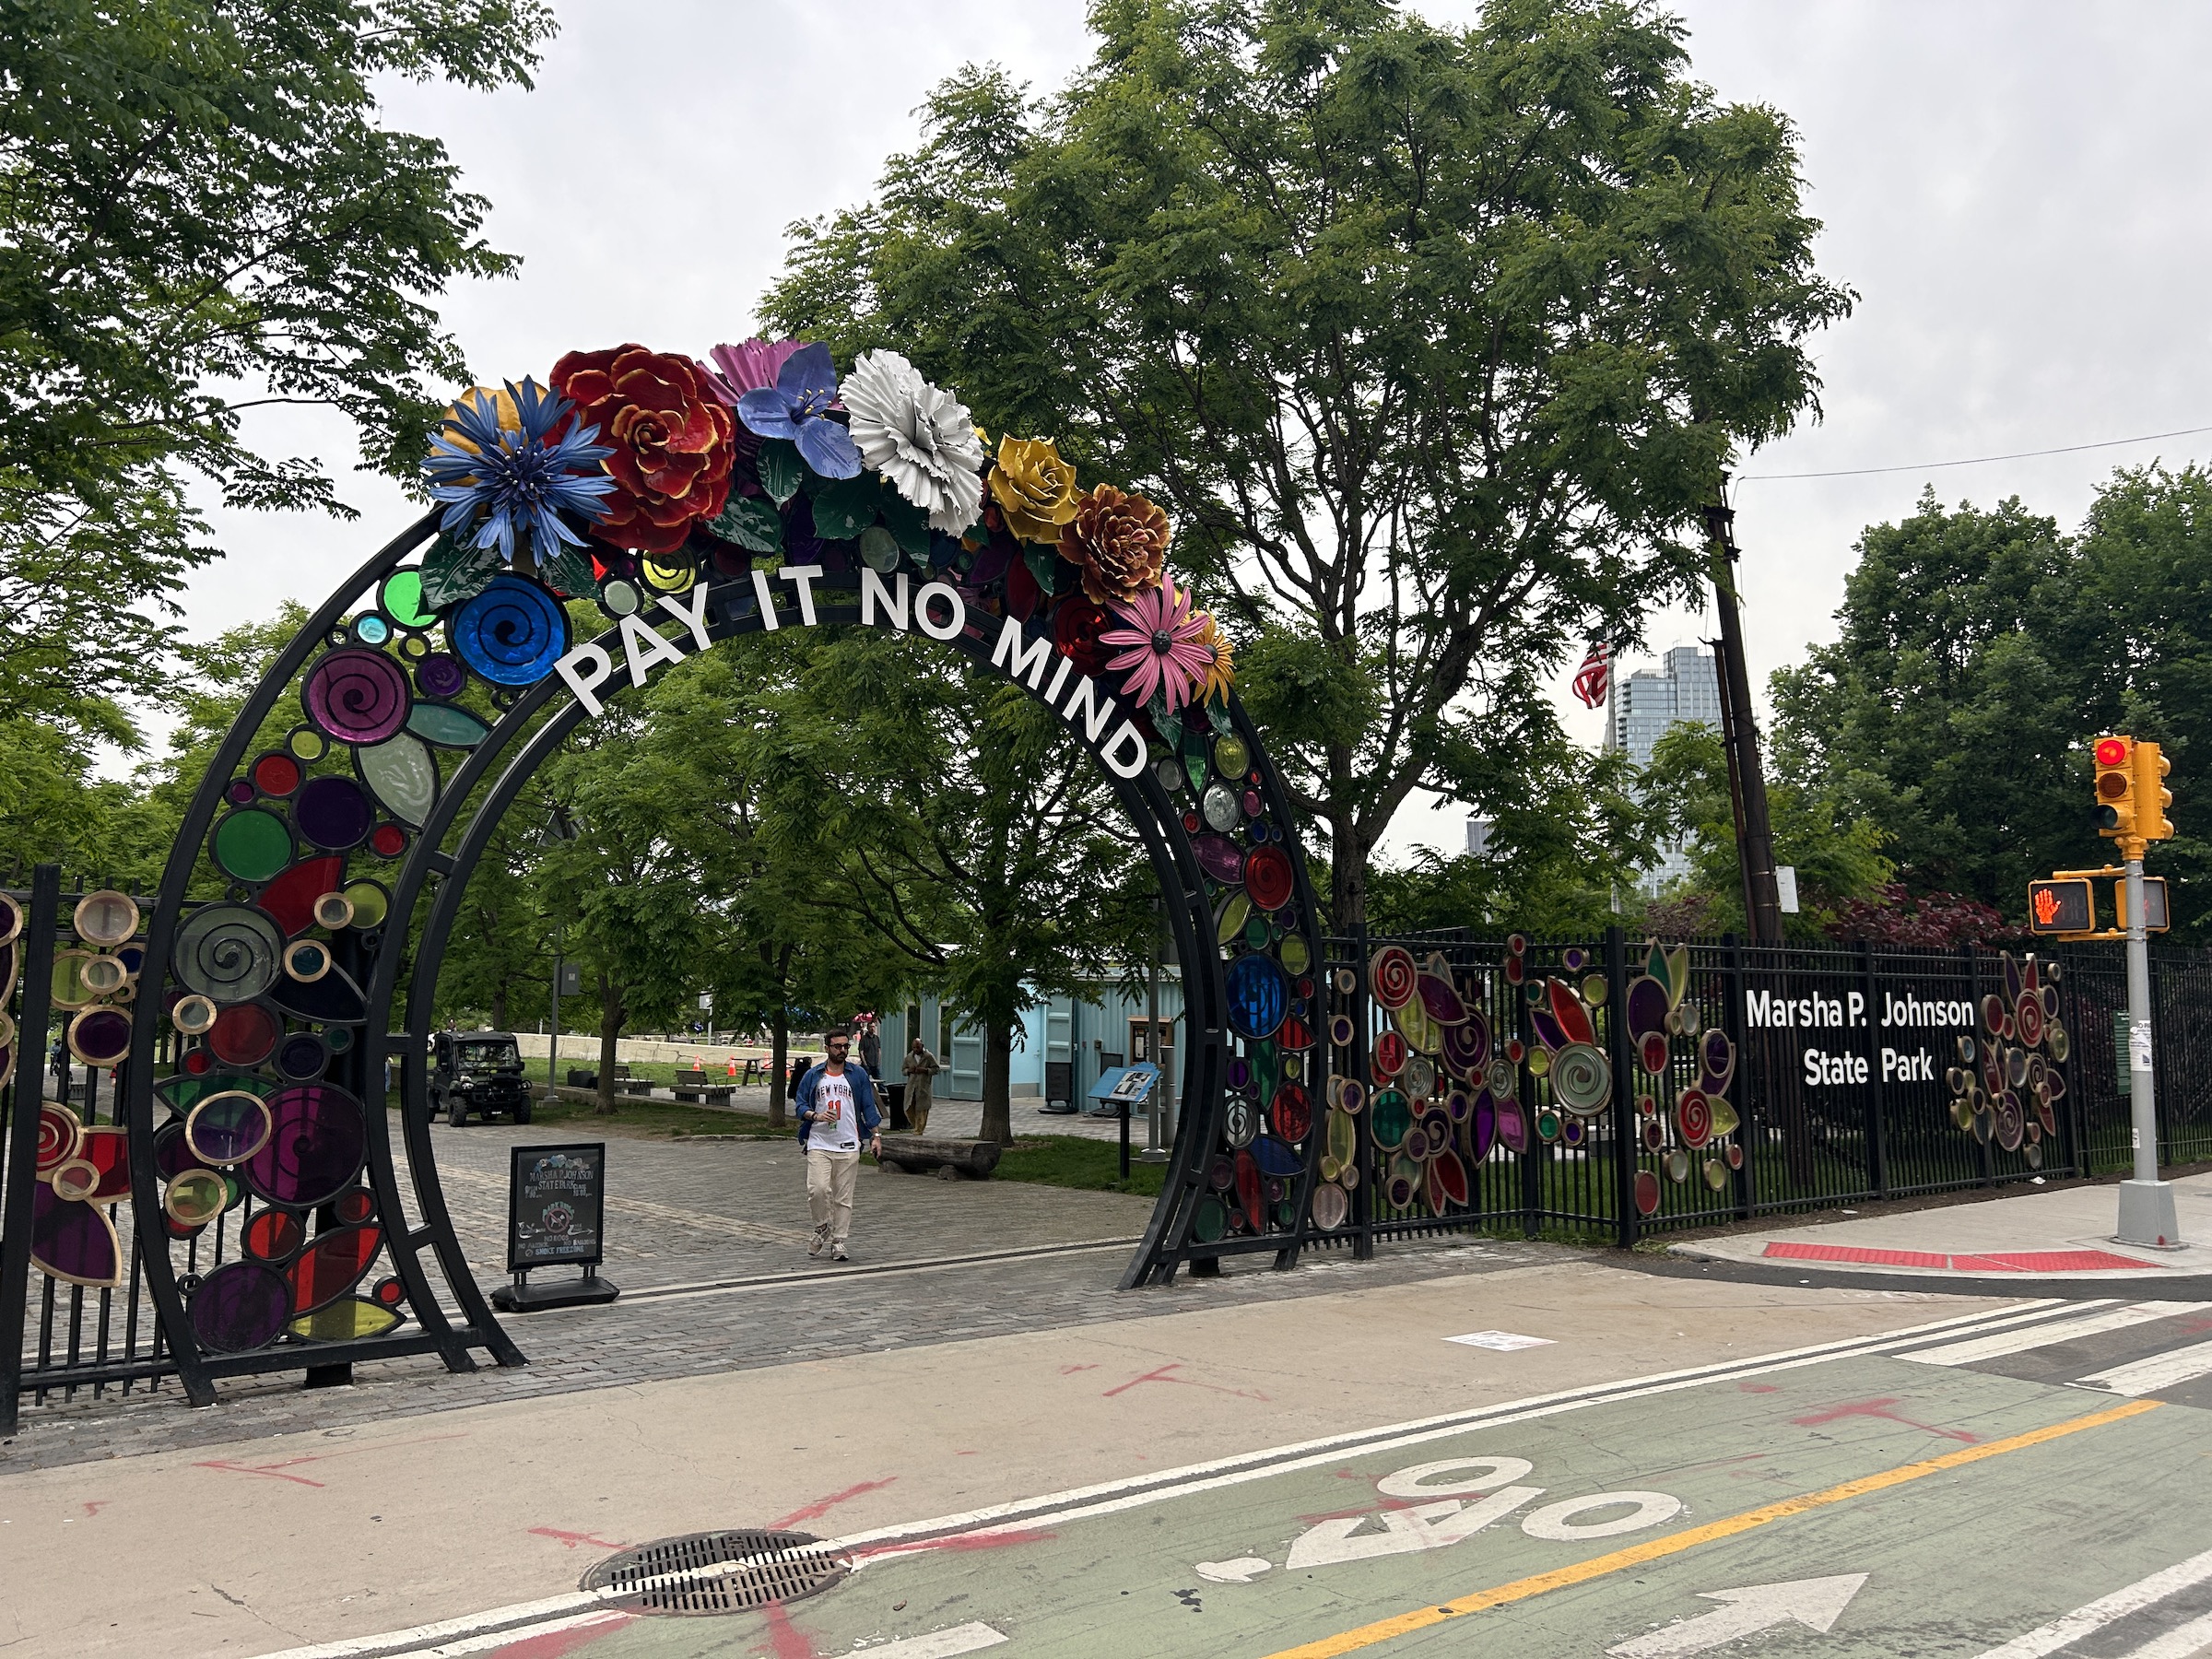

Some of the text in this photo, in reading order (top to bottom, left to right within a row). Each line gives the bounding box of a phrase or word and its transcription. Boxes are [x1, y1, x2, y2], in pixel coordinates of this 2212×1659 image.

[553, 564, 1147, 780] PAY IT NO MIND
[1746, 989, 1974, 1028] Marsha P. Johnson
[1804, 1046, 1935, 1087] State Park
[833, 1084, 853, 1101] YORK
[828, 1100, 841, 1120] 11
[530, 1171, 558, 1182] MARSHA
[564, 1170, 594, 1181] JOHNSON
[538, 1181, 559, 1190] STATE
[535, 1246, 556, 1255] SMOKE
